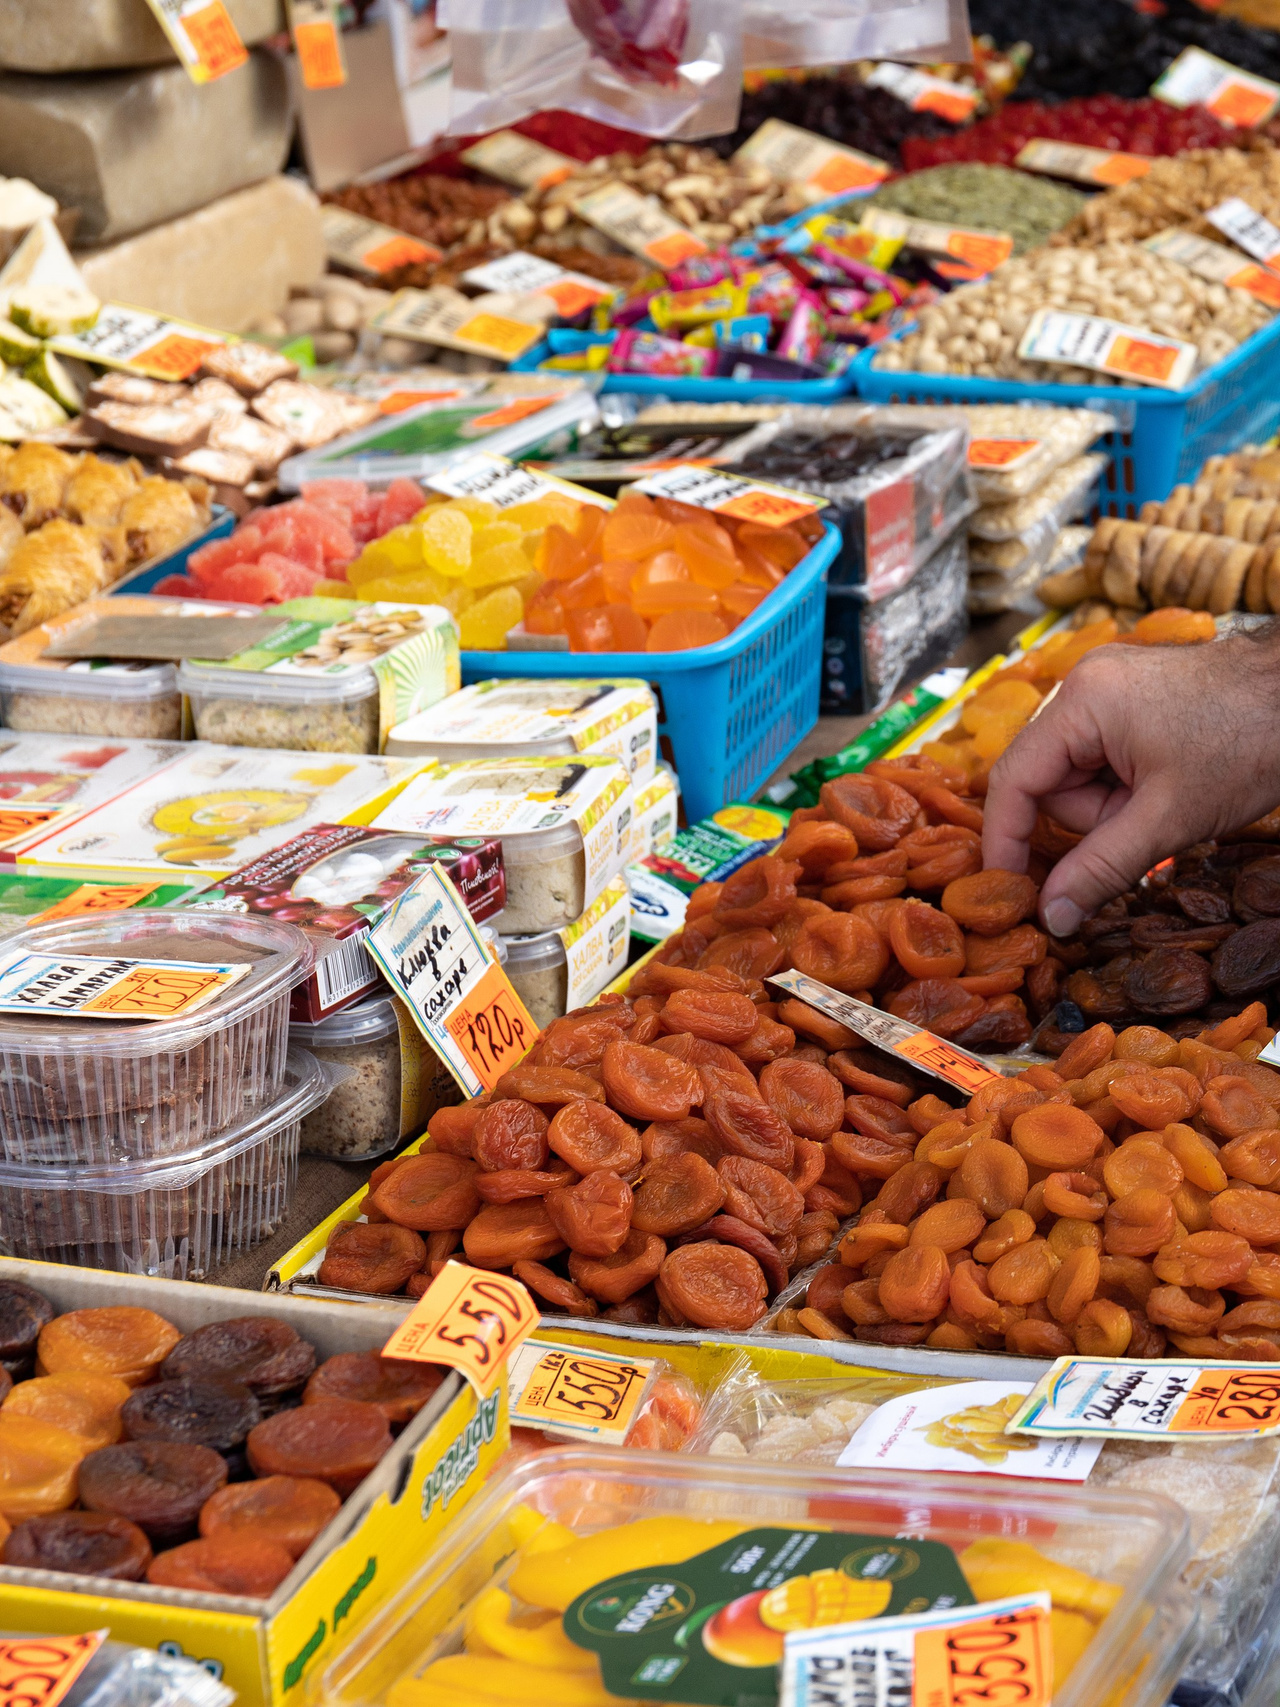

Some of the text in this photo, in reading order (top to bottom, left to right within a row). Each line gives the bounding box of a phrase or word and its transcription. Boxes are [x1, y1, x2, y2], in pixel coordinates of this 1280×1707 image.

[94, 993, 122, 1009] ЦЕНА
[450, 1008, 473, 1036] ЦЕНА
[396, 1321, 430, 1353] ЦЕНА
[437, 1281, 521, 1365] 550
[525, 1385, 546, 1406] ЦЕНА
[421, 1387, 500, 1521] Apricot
[615, 1584, 676, 1633] KONG
